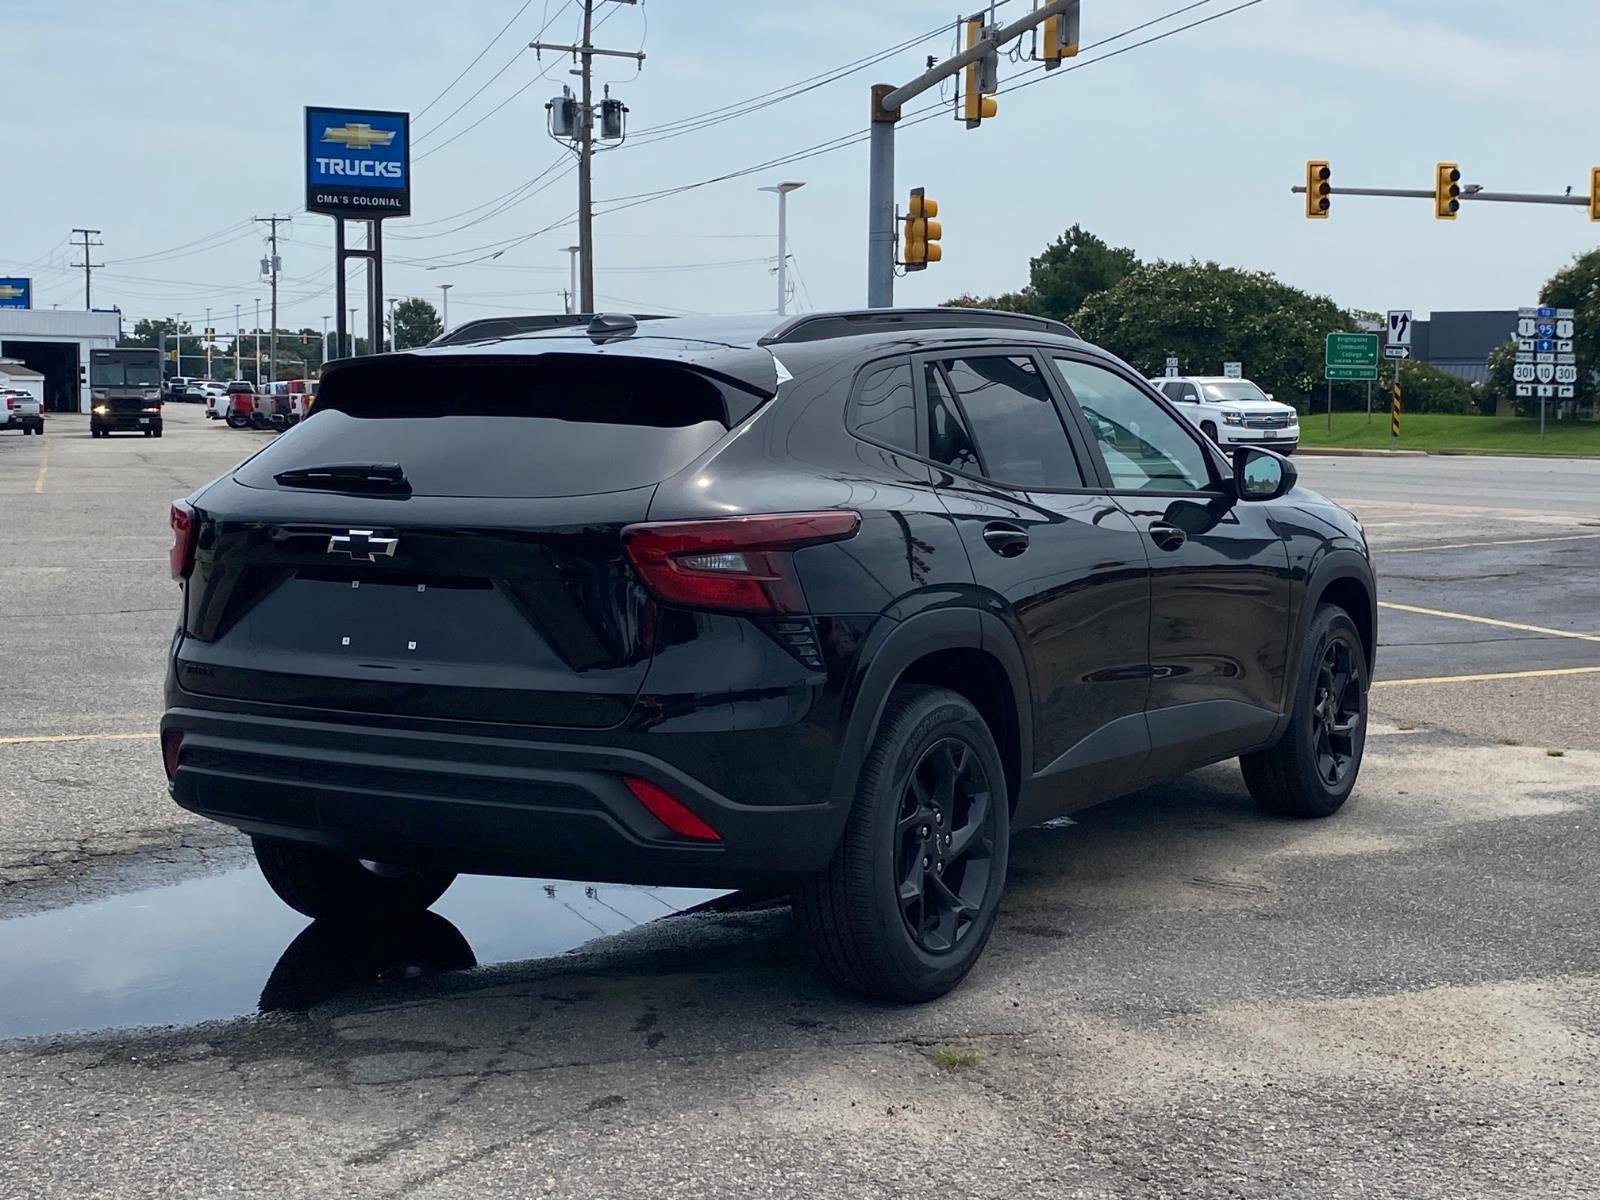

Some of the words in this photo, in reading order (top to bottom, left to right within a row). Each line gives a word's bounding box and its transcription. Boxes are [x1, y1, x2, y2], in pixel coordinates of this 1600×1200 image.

[316, 157, 402, 178] TRUCKS
[316, 194, 349, 204] CMA'S
[352, 196, 402, 207] COLONIAL
[1539, 324, 1552, 335] 95
[1516, 367, 1532, 378] 301
[1541, 368, 1550, 378] 10
[1558, 368, 1574, 379] 301
